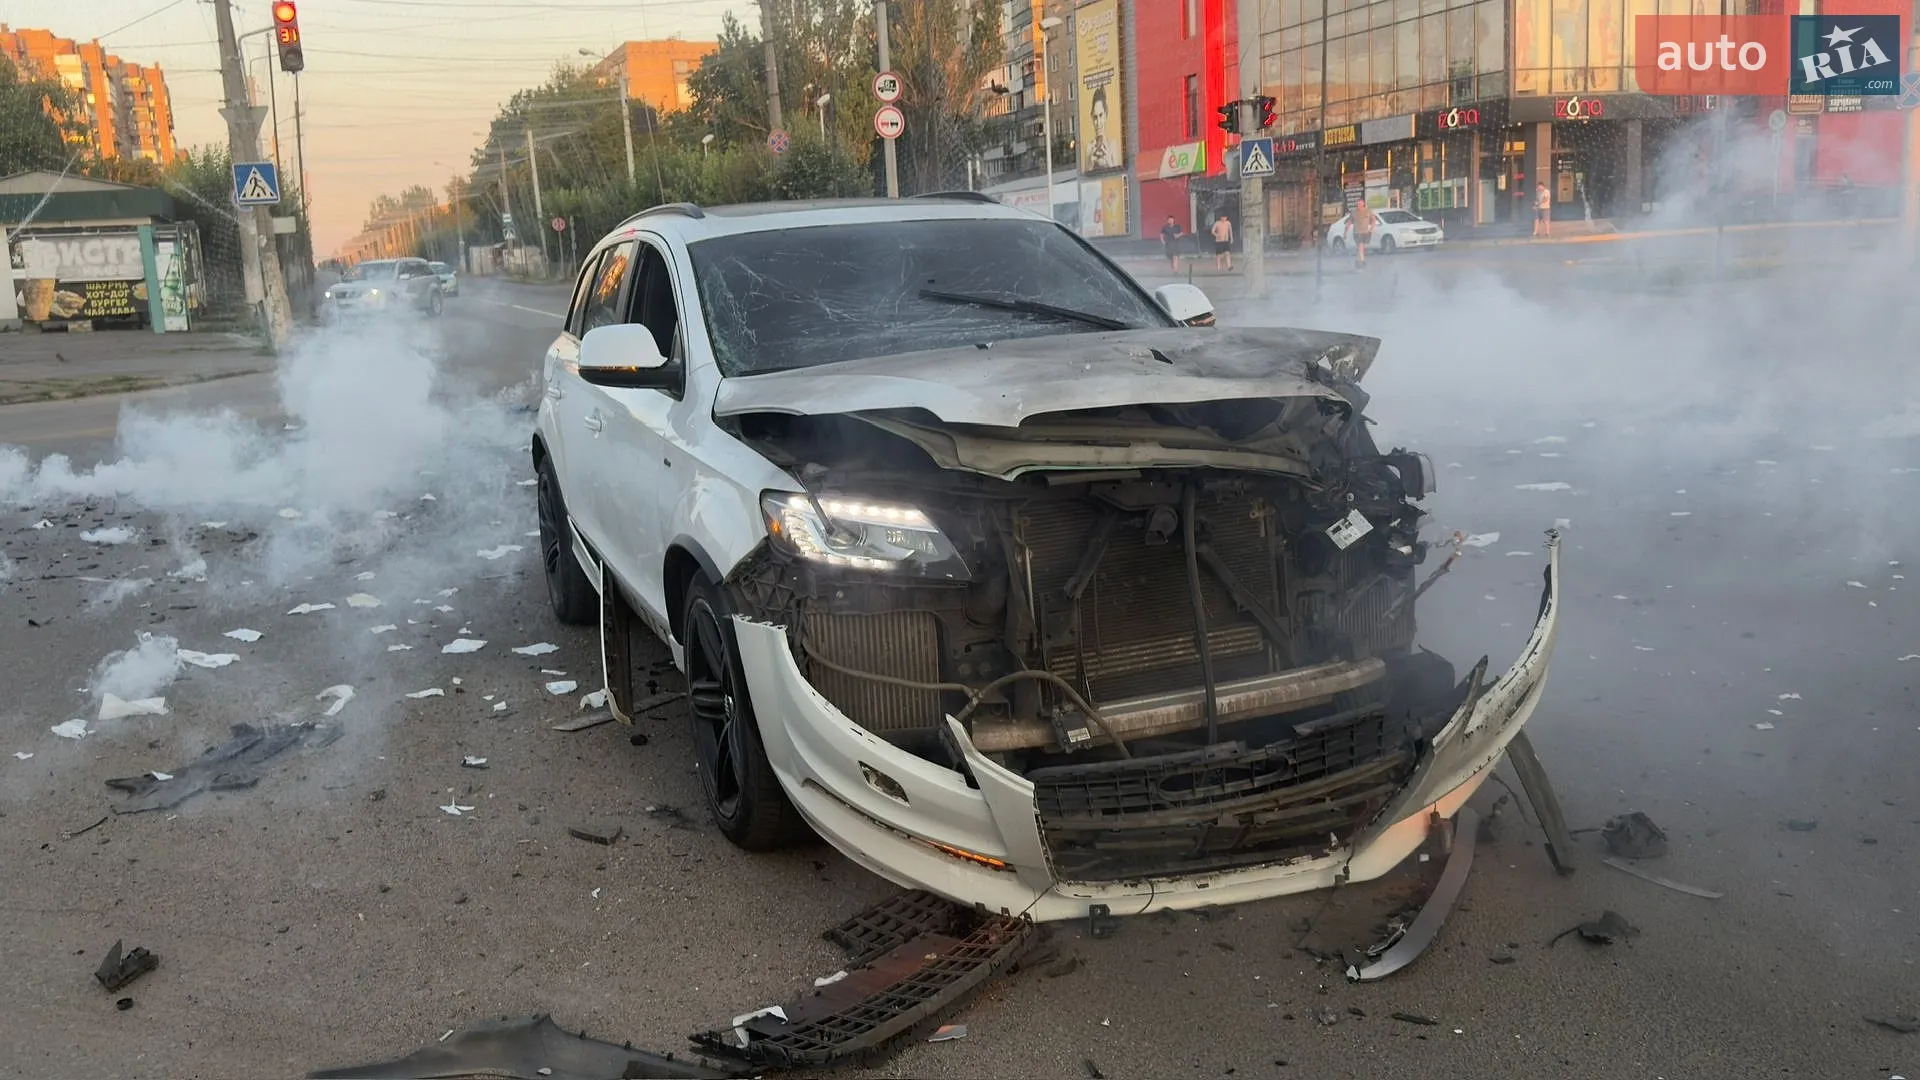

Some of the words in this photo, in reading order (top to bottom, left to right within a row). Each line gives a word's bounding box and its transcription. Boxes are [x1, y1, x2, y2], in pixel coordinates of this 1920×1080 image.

[280, 28, 297, 42] 31
[86, 281, 128, 290] ШАУРМА
[86, 290, 130, 299] ХОТ-ДОГ
[91, 298, 128, 307] БУРГЕР
[84, 307, 105, 317] ЧАЙ
[111, 307, 136, 315] КАВА
